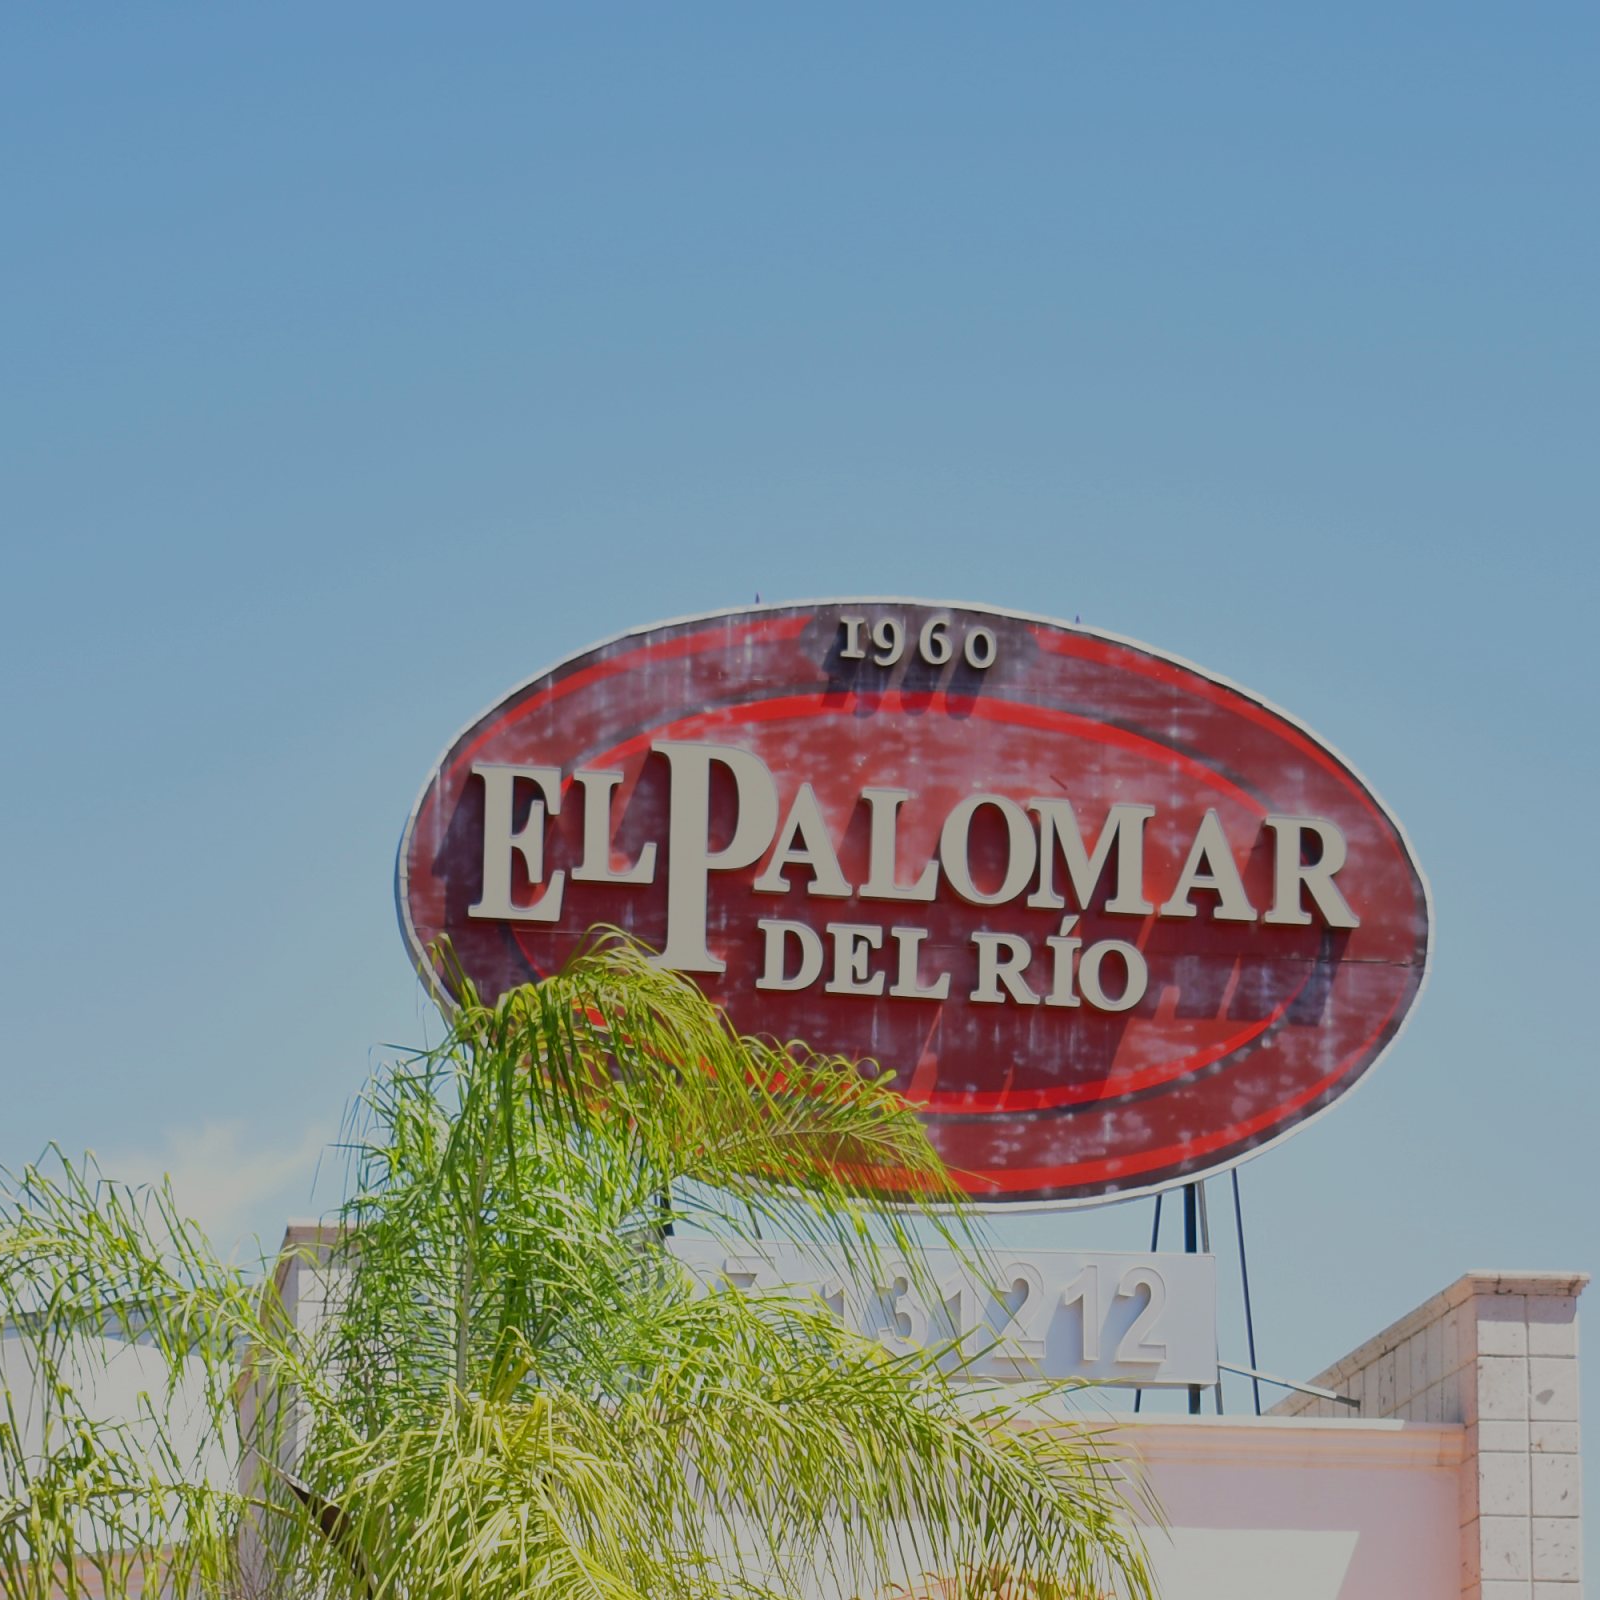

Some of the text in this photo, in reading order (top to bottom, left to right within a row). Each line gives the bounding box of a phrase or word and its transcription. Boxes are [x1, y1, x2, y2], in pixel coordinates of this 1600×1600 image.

[840, 615, 999, 670] 1960
[467, 740, 1360, 974] EL PALOMAR
[756, 915, 1149, 1012] DEL RÍO
